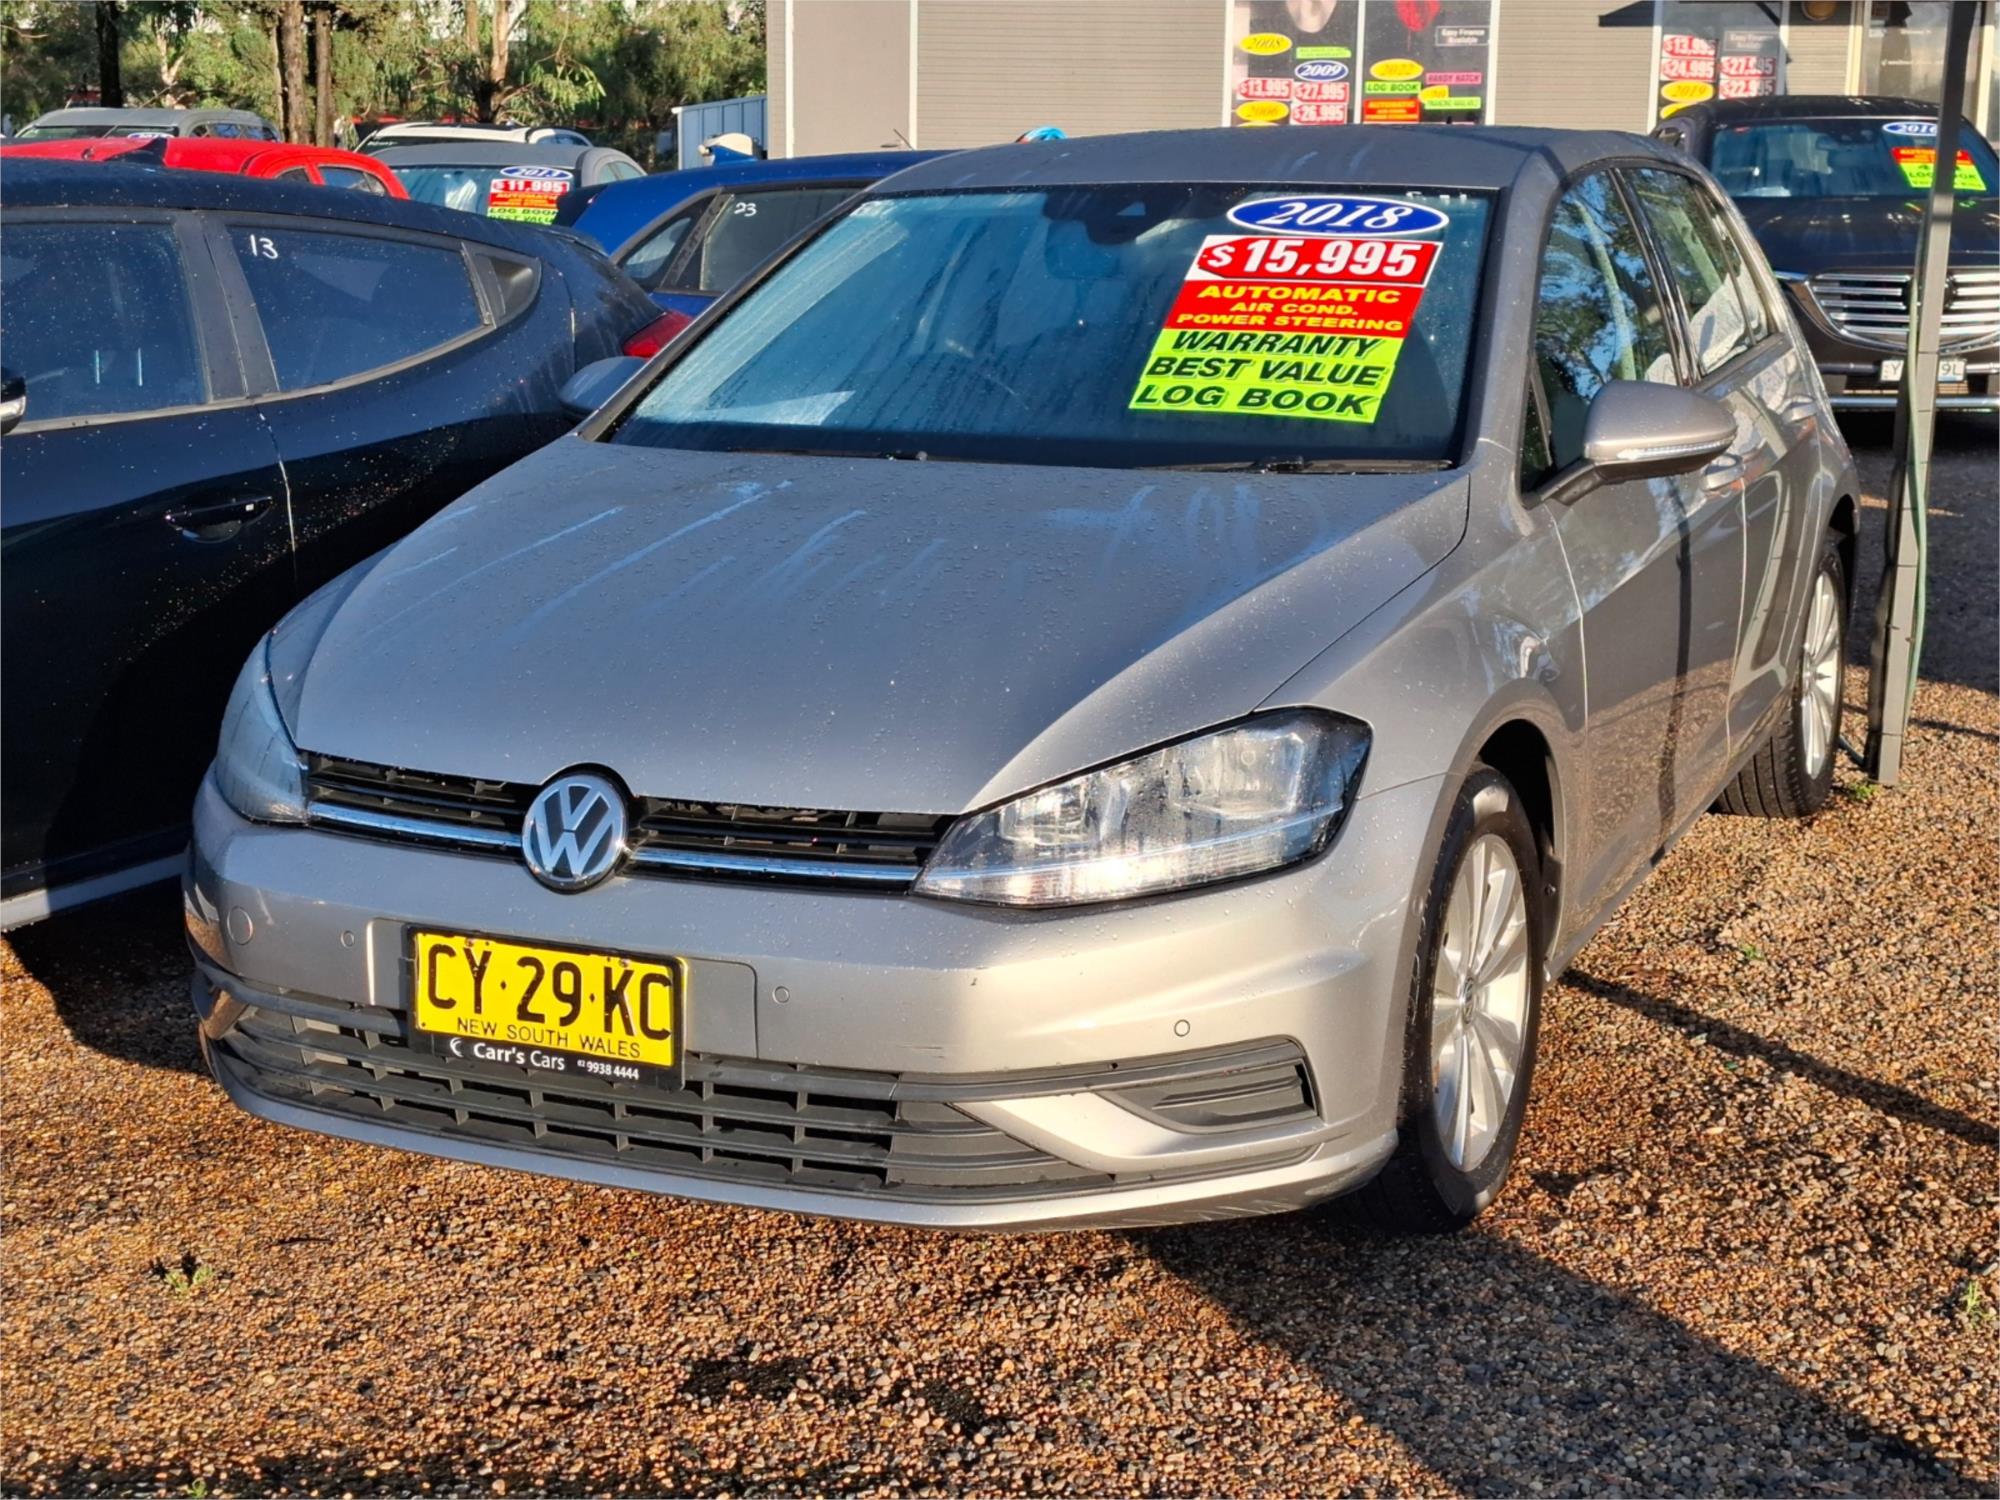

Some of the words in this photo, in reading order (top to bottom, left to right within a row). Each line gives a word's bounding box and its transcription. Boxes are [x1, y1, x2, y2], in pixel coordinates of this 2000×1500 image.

[1300, 64, 1342, 76] 2009
[1367, 83, 1385, 91] LOG
[1390, 83, 1417, 91] BOOK
[493, 180, 563, 193] $11,995
[734, 202, 757, 217] 23
[1256, 203, 1414, 229] 2018
[250, 234, 278, 260] 13
[1197, 285, 1401, 304] AUTOMATIC
[1230, 302, 1273, 313] AIR
[1281, 303, 1358, 315] COND.
[1176, 313, 1266, 326] POWER
[1273, 316, 1404, 332] STEERING
[1171, 330, 1384, 358] WARRANTY
[1145, 357, 1252, 378] BEST
[1259, 361, 1387, 387] VALUE
[1134, 384, 1227, 407] LOG
[1237, 387, 1376, 416] BOOK
[457, 1017, 497, 1037] NEW
[507, 1024, 568, 1048] SOUTH
[579, 1034, 641, 1059] WALES
[473, 1042, 526, 1065] Carr's
[530, 1051, 566, 1071] Cars
[587, 1060, 612, 1076] 9938
[613, 1065, 640, 1081] 4444
